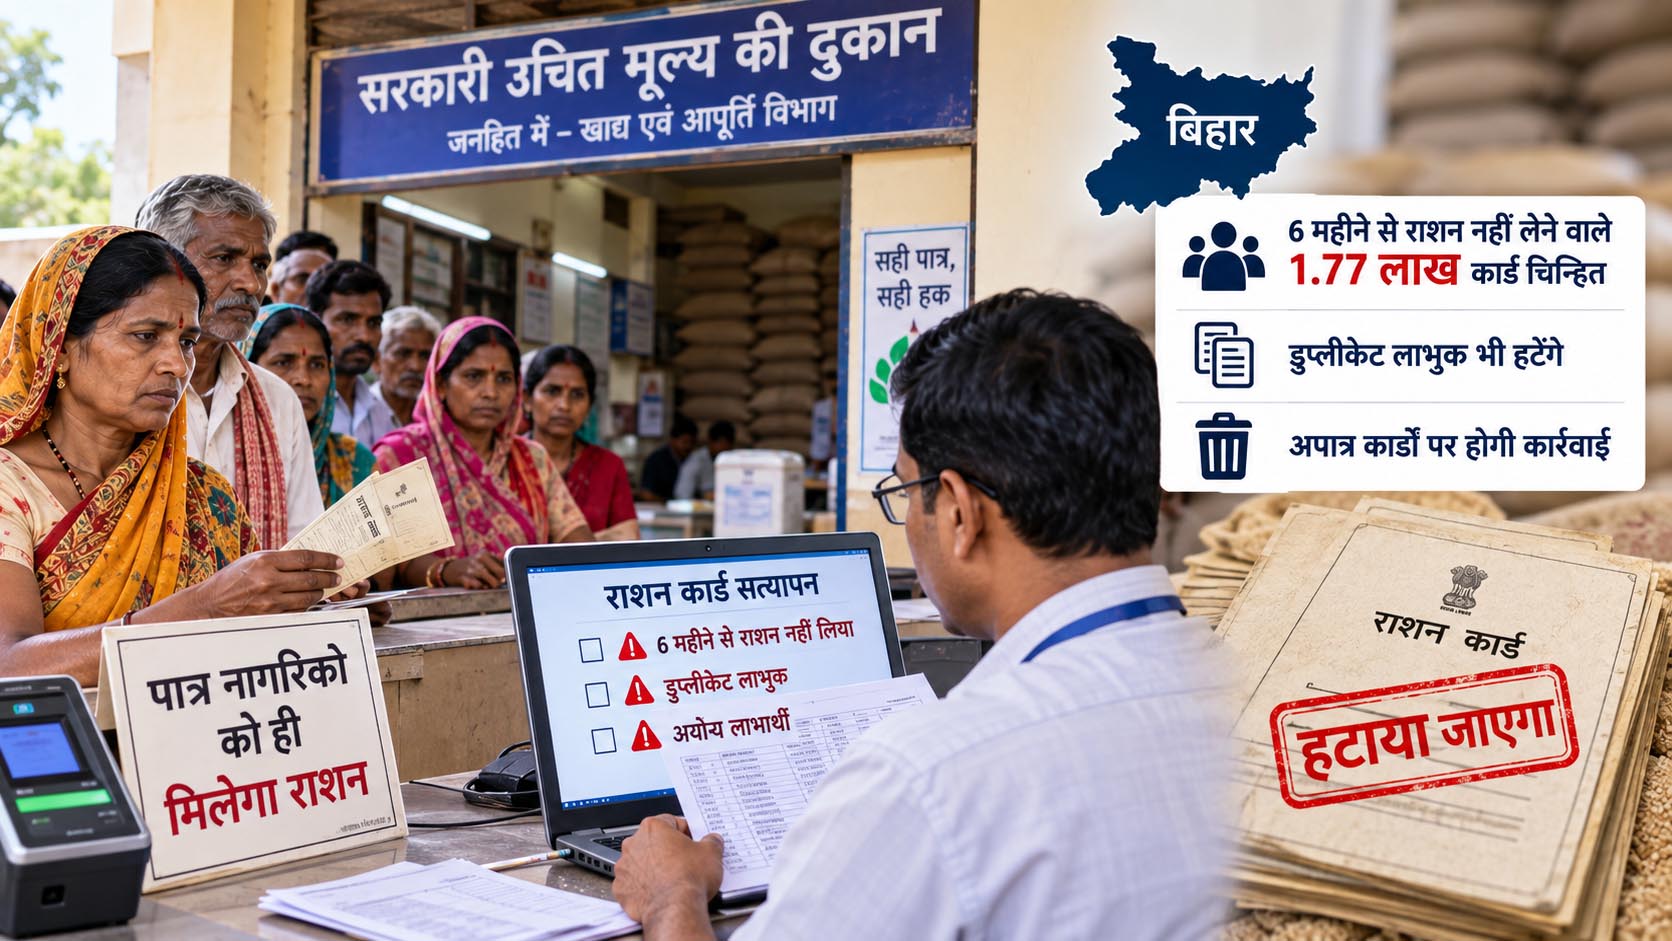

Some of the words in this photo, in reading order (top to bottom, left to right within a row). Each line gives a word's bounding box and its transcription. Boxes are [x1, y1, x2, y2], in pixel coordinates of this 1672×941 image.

[357, 46, 493, 115] सरकारी
[505, 38, 609, 98] उचित
[623, 35, 720, 101] मूल्य
[733, 11, 793, 73] की
[807, 7, 942, 82] दुकान
[447, 119, 523, 154] जनहित
[530, 115, 549, 147] में
[579, 115, 631, 143] खाद्य
[639, 103, 673, 142] एवं
[682, 94, 756, 140] आपूर्ति
[763, 91, 838, 127] विभाग
[874, 243, 910, 274] सही
[915, 248, 955, 272] पात्र,
[876, 279, 912, 310] सही
[918, 284, 952, 309] हक
[604, 582, 671, 610] राशन
[678, 570, 729, 603] कार्ड
[735, 572, 819, 601] सत्यापन
[657, 636, 669, 654] 6
[673, 627, 714, 654] महीने
[718, 625, 735, 648] से
[739, 627, 780, 646] राशन
[784, 618, 813, 644] नहीं
[816, 617, 855, 640] लिया
[1373, 611, 1450, 645] राशन
[1464, 629, 1528, 659] कार्ड
[147, 672, 211, 711] पात्र
[219, 643, 349, 700] नागरिको
[663, 670, 733, 704] डुप्लीकेट
[737, 668, 788, 693] लाभुक
[218, 711, 261, 758] को
[269, 705, 302, 755] ही
[728, 707, 790, 736] लाभार्थी
[1296, 714, 1430, 782] हटाया
[1437, 699, 1555, 749] जाएगा
[163, 775, 279, 837] मिलेगा
[286, 761, 369, 809] राशन
